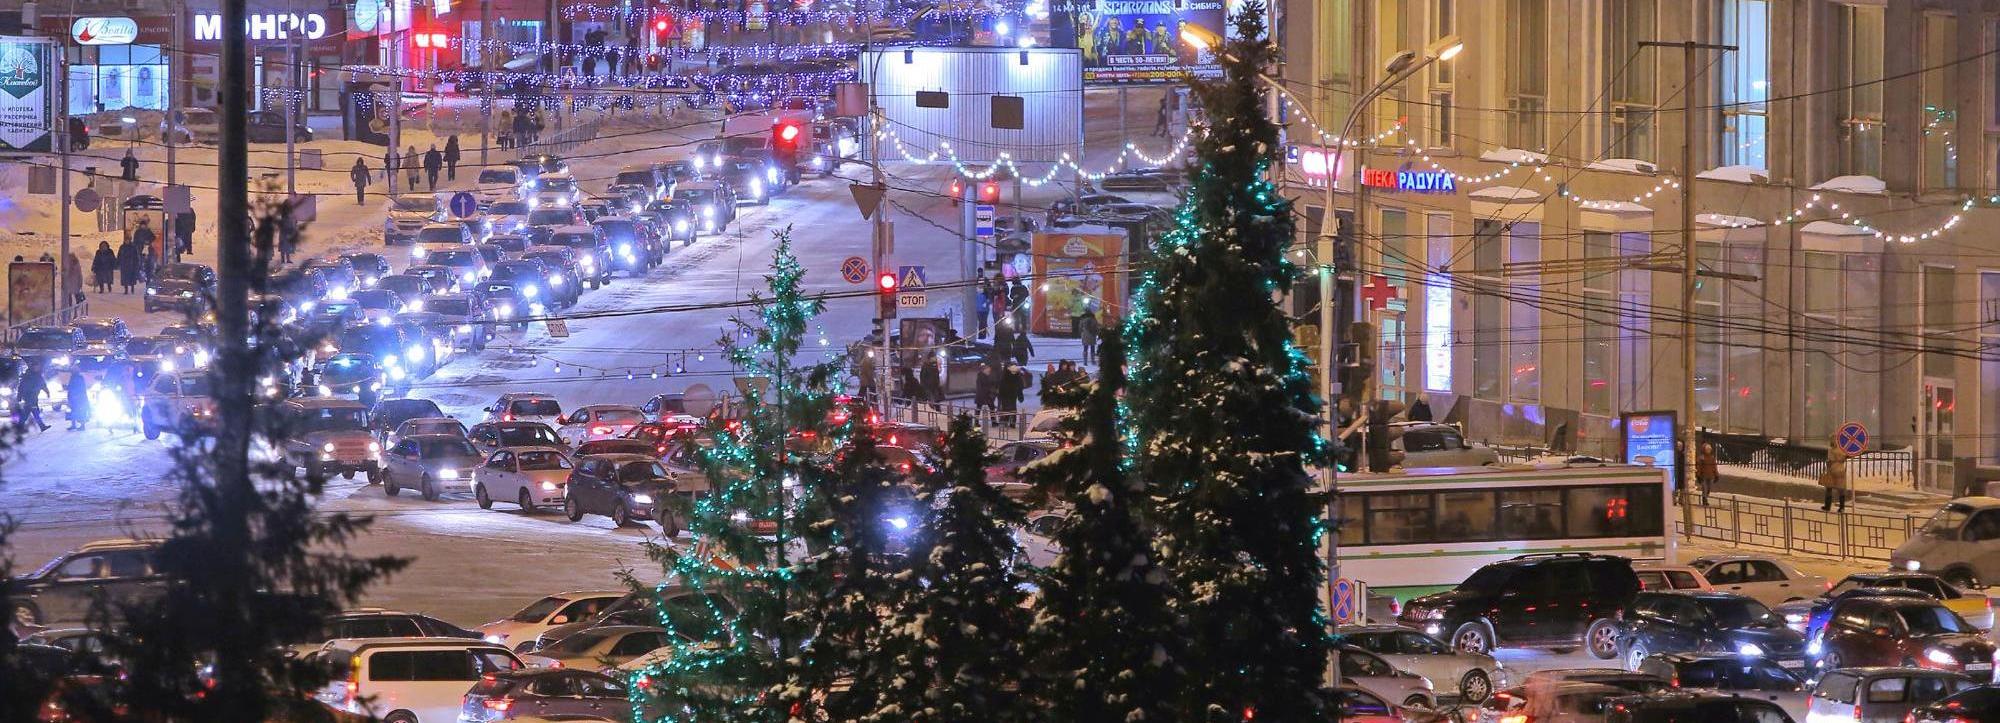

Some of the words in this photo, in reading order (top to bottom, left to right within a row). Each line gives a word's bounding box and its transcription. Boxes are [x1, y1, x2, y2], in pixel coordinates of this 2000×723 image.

[1190, 2, 1222, 11] СИБИРЬ
[194, 13, 326, 40] МНРО
[1398, 172, 1454, 190] РАДУГА
[901, 295, 925, 305] СТОП
